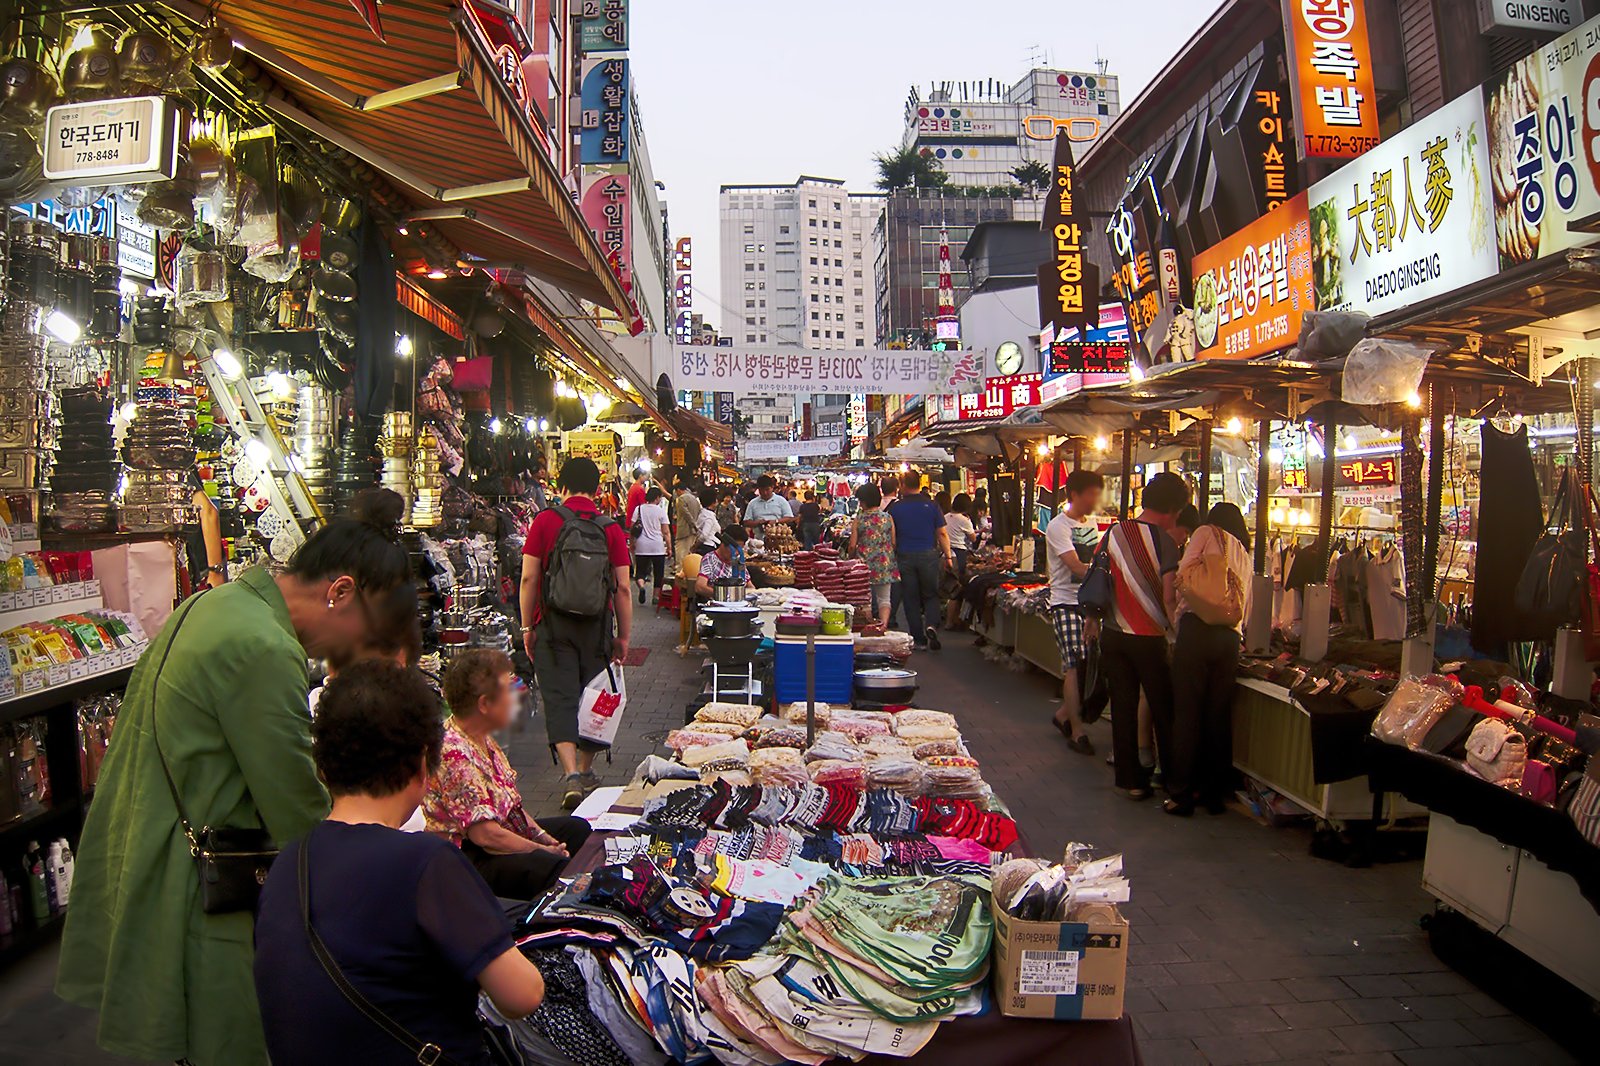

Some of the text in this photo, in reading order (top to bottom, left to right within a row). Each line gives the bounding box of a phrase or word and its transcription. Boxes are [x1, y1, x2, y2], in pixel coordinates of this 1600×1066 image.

[584, 2, 599, 16] 2F
[1505, 2, 1571, 25] GINSENG
[1059, 87, 1106, 101] 스크린골프
[583, 108, 598, 125] 1F
[602, 60, 625, 157] 생활잡화
[60, 120, 140, 149] 한국도자기
[919, 119, 972, 132] 스크린골프
[76, 149, 119, 163] 778-8484
[1513, 94, 1577, 224] 중앙
[1347, 136, 1454, 266] 大都人蔘
[1054, 223, 1084, 313] 안경원
[1365, 252, 1441, 303] DAEDO GINSENG
